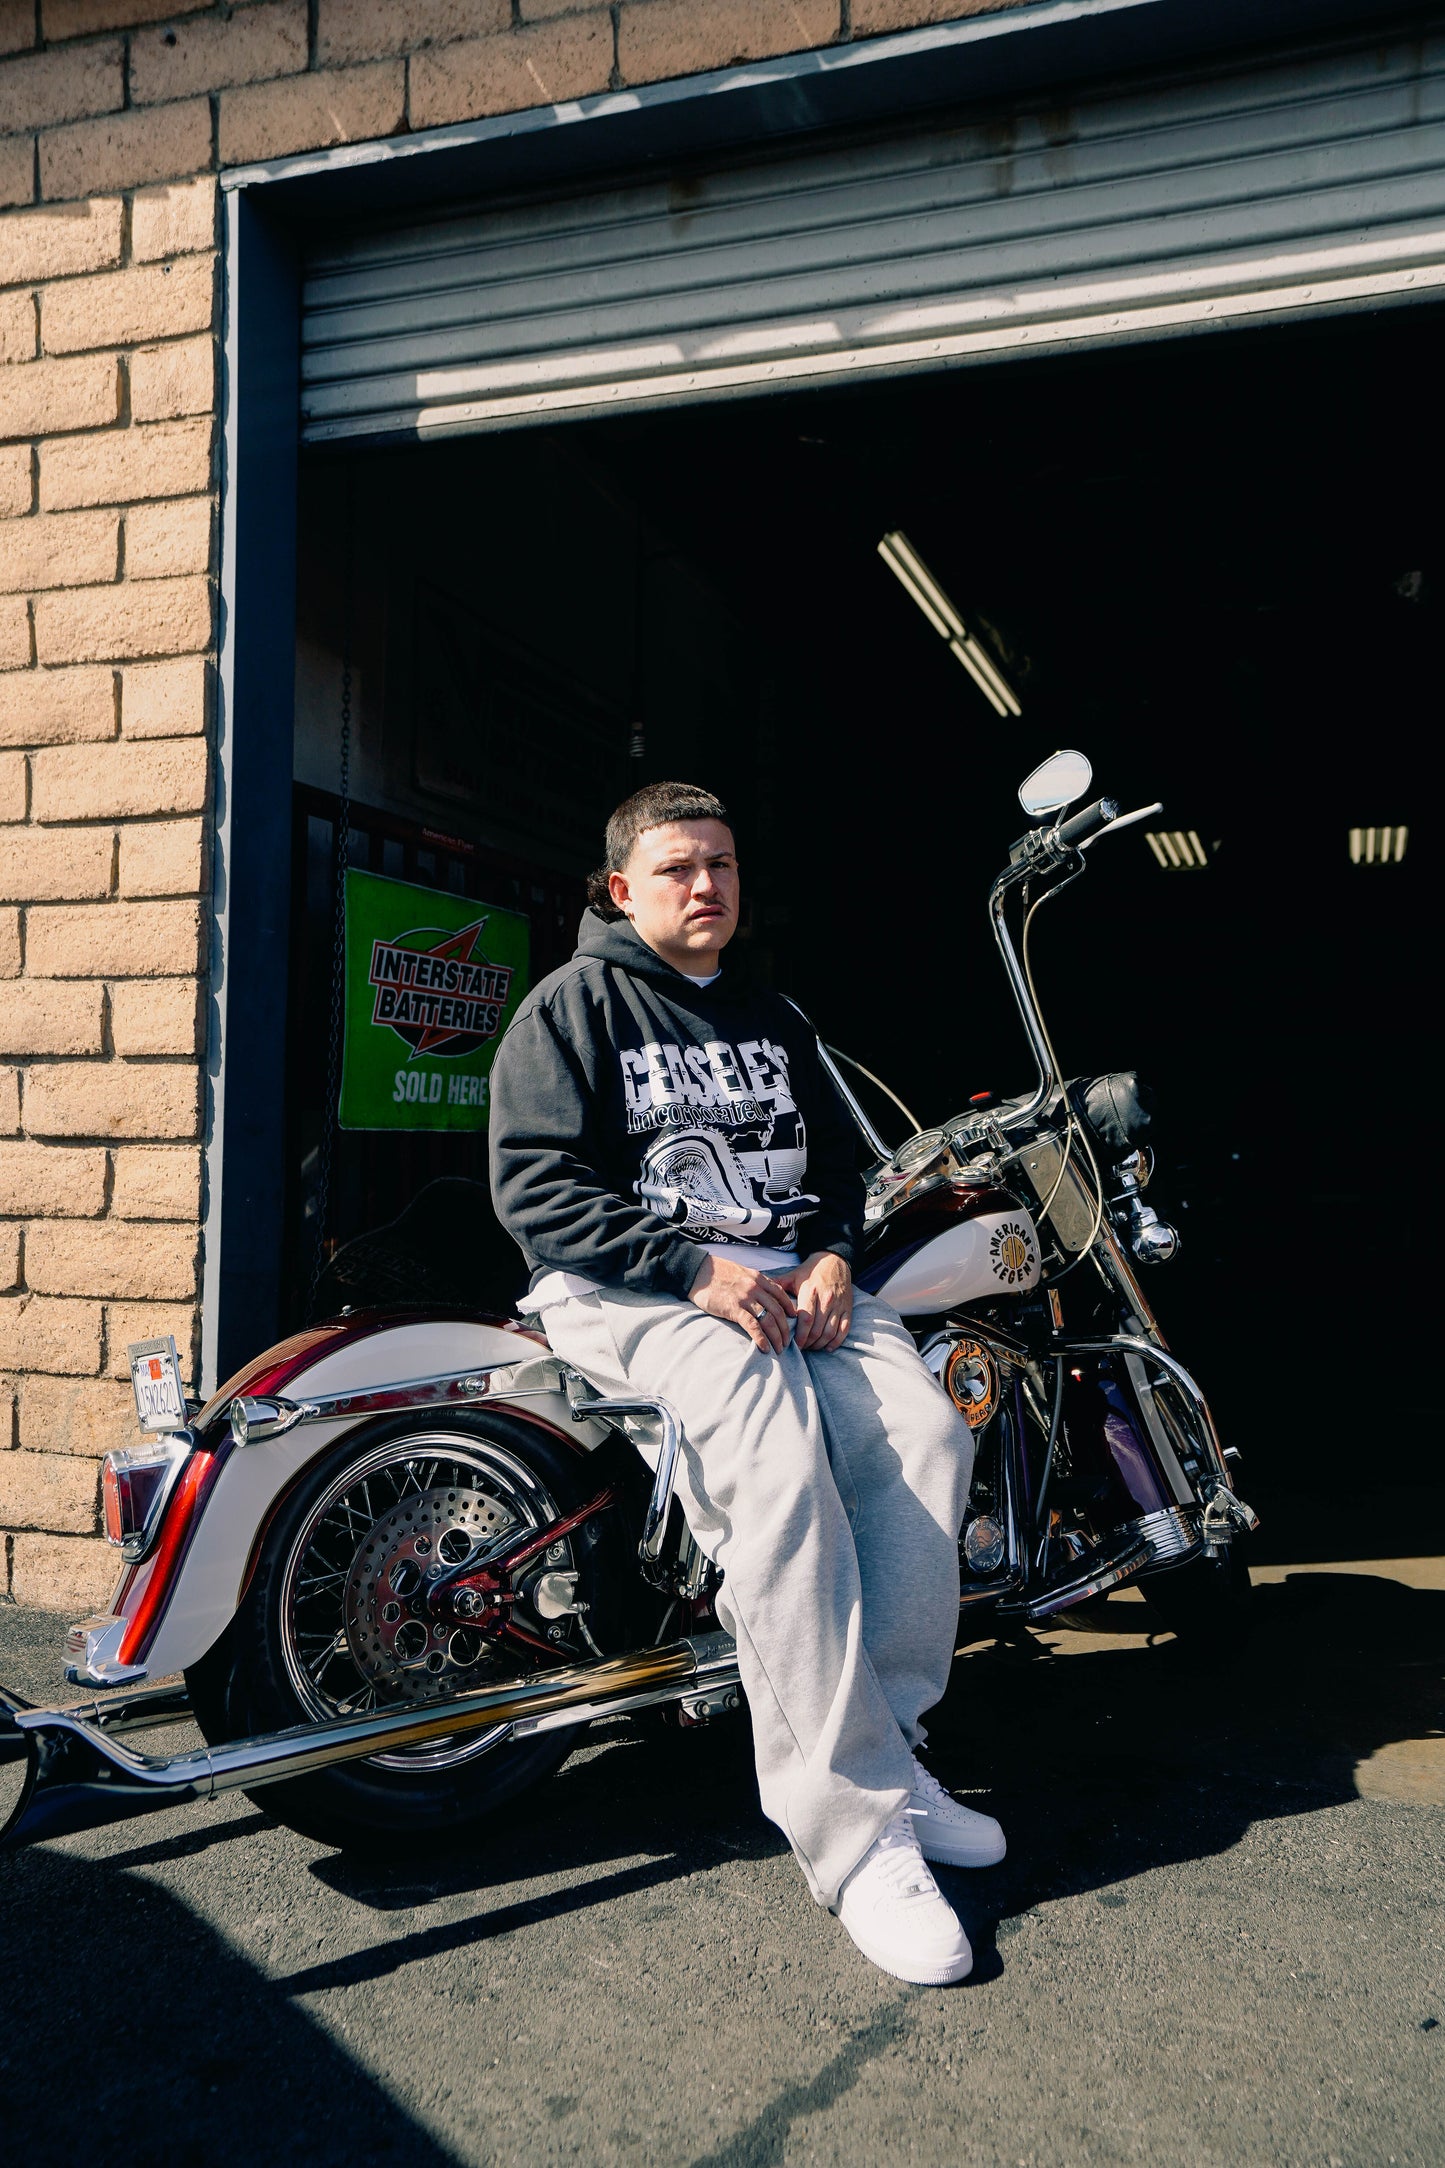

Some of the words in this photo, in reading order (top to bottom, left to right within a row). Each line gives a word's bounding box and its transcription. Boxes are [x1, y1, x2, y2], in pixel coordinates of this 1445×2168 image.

[374, 948, 509, 1000] INTERSTATE
[378, 988, 500, 1033] BATTERIES
[393, 1070, 442, 1104] SOLD
[447, 1073, 487, 1106] HERE
[989, 1222, 1032, 1256] AMERICAN
[992, 1254, 1035, 1284] LEGEND
